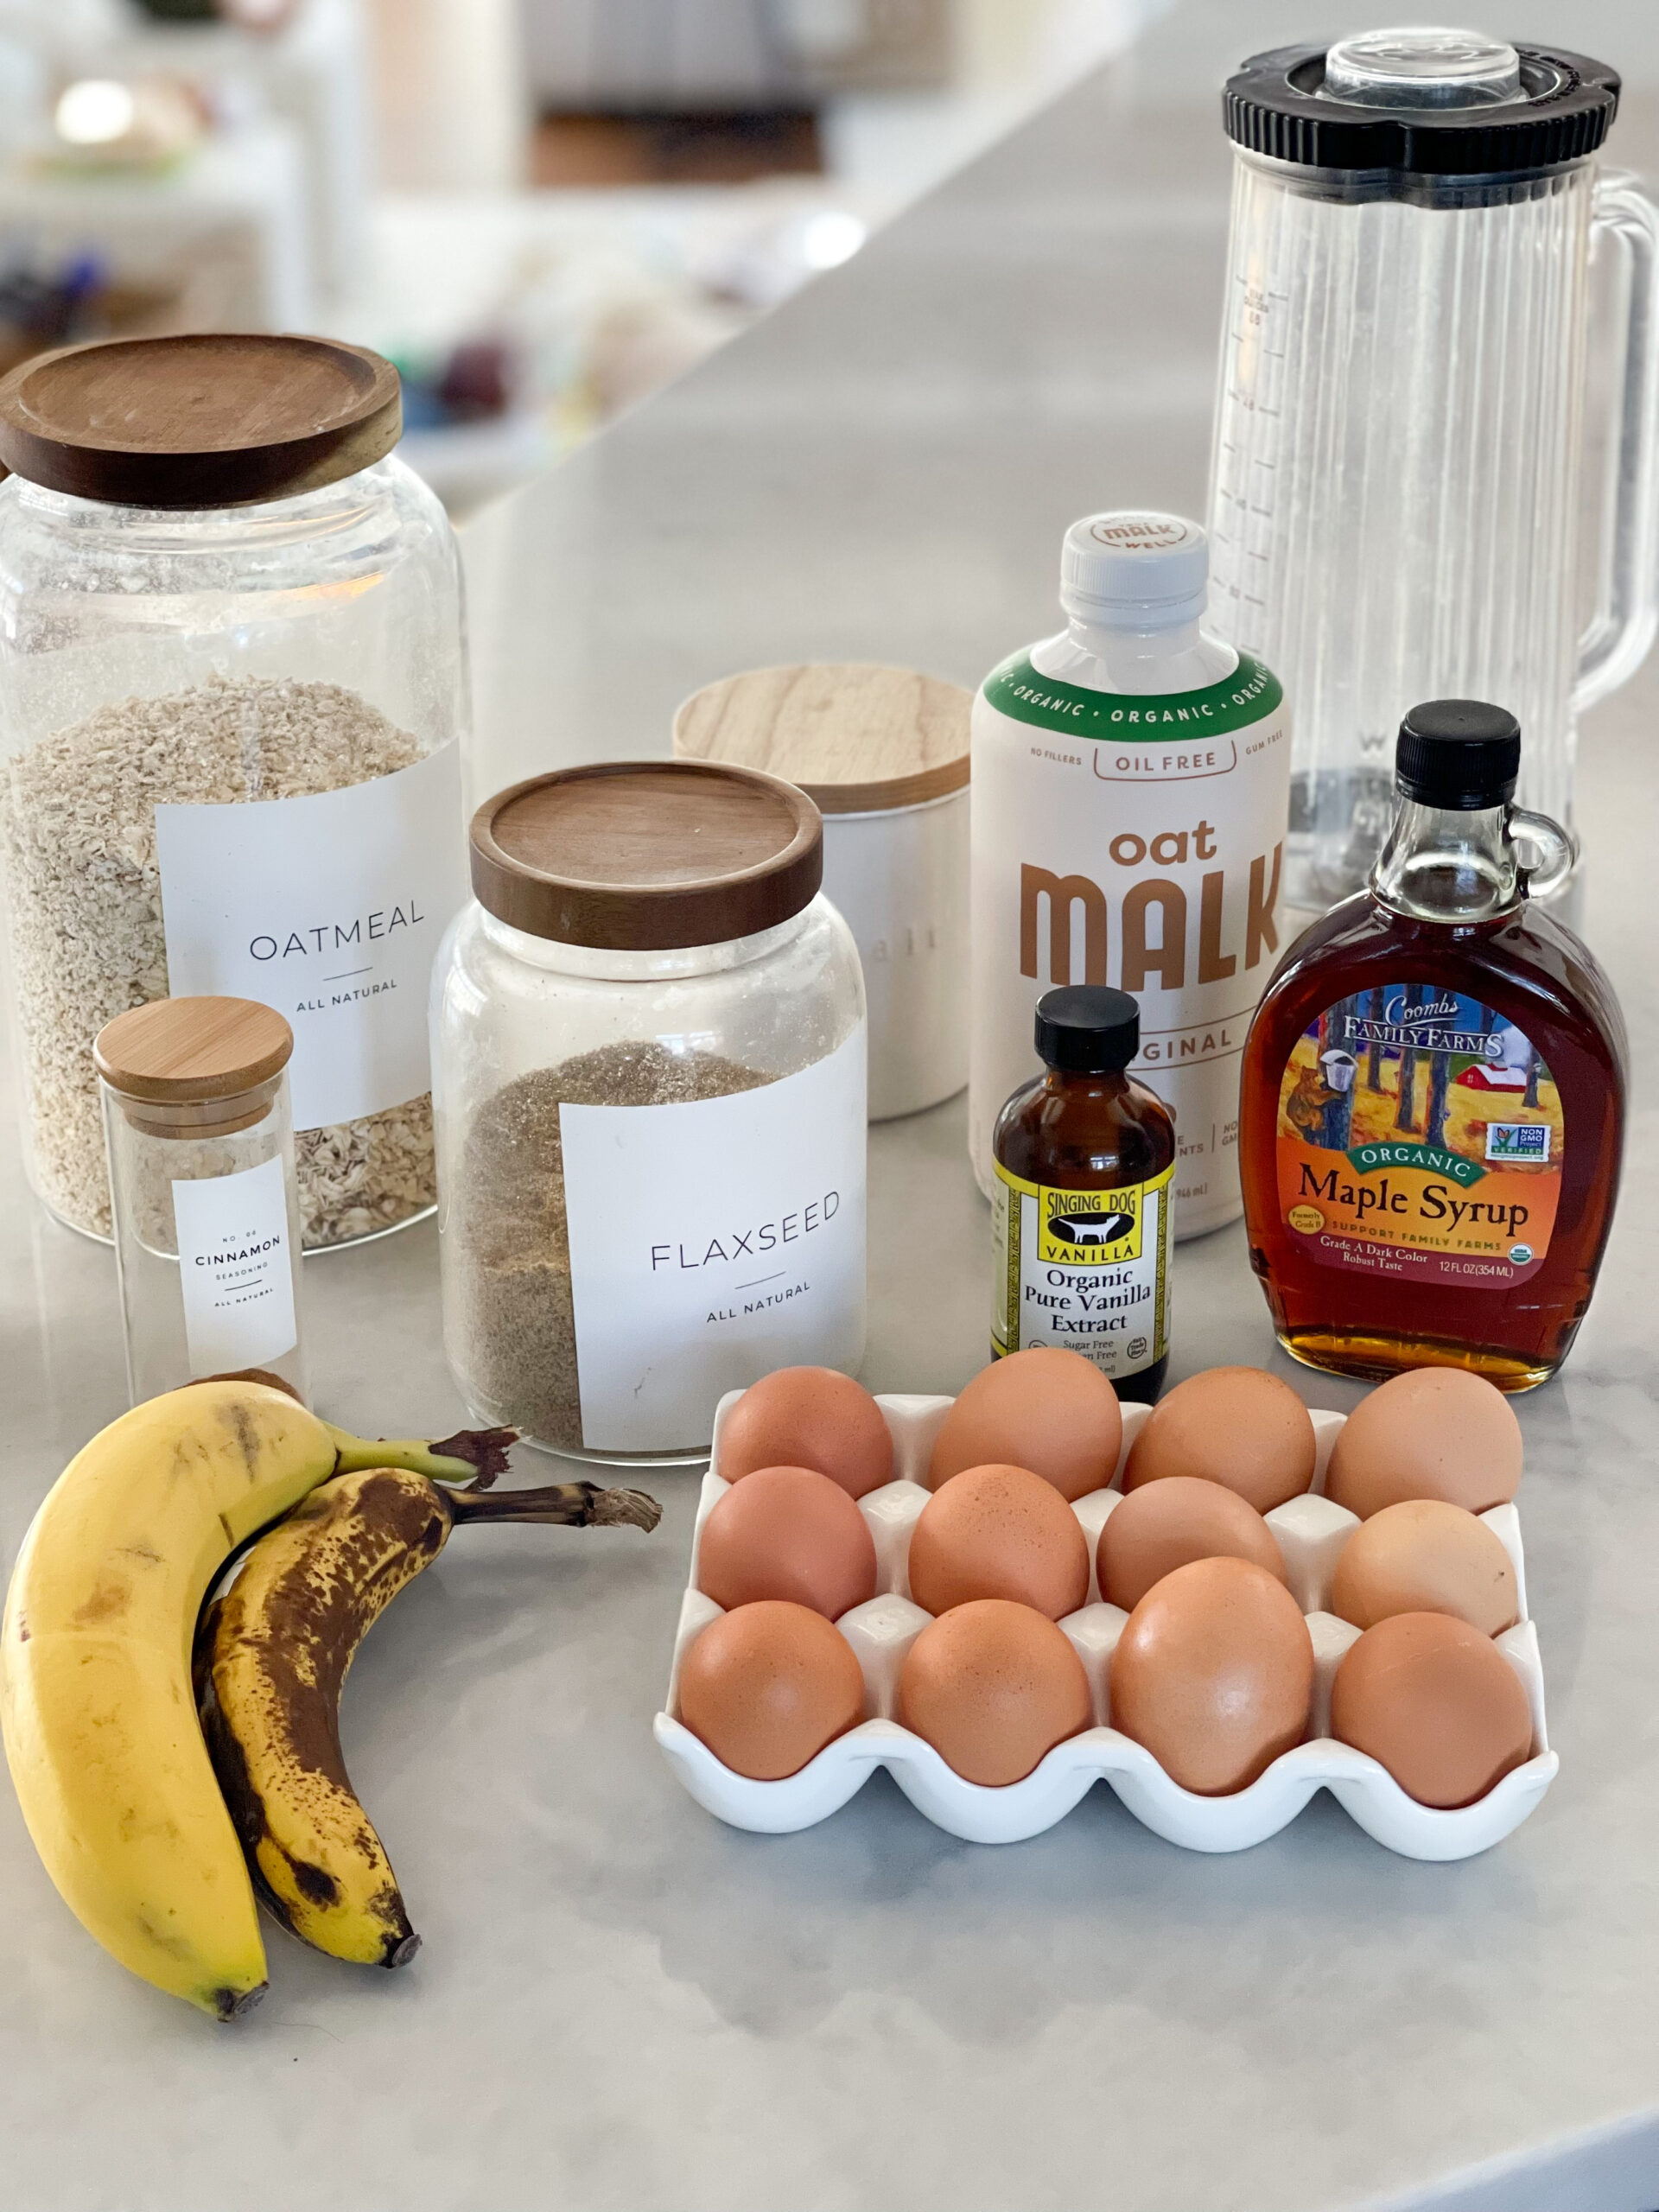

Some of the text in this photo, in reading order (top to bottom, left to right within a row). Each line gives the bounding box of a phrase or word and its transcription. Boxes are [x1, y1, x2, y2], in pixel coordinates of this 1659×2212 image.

[1125, 540, 1177, 549] WELL
[1013, 662, 1268, 722] ORGANIC ORGANIC ORGANIC
[1031, 747, 1082, 766] NO FILLERS
[1245, 731, 1283, 755] GUM FREE
[1116, 753, 1216, 772] OIL FREE
[1109, 820, 1217, 867] oat
[251, 900, 424, 960] OATMEAL
[296, 979, 397, 1012] ALL NATURAL
[1385, 994, 1459, 1026] Coombs
[1143, 1029, 1231, 1061] GINAL
[1344, 1016, 1503, 1058] FAMILY FARMS
[1361, 1147, 1471, 1178] ORGANIC
[1046, 1191, 1135, 1218] SINGING DOG
[1299, 1162, 1529, 1237] Maple Syrup
[652, 1192, 839, 1271] FLAXSEED
[1332, 1221, 1501, 1250] SUPPORT FAMILY FARMS
[195, 1235, 280, 1266] CINNAMON
[1046, 1244, 1134, 1262] VANILLA
[1320, 1236, 1427, 1262] Grade A Dark Color
[1344, 1252, 1402, 1271] Robust Taste
[216, 1262, 267, 1280] SEASONING
[1047, 1268, 1133, 1294] Organic
[1440, 1262, 1450, 1272] 12
[1452, 1262, 1462, 1273] FL
[1497, 1267, 1514, 1279] ML)
[236, 1288, 273, 1304] NATURAL
[707, 1281, 810, 1323] ALL NATURAL
[1025, 1285, 1151, 1312] Pure Vanilla
[1051, 1314, 1128, 1333] Extract
[1064, 1340, 1114, 1351] Sugar Free
[1096, 1351, 1117, 1360] Free
